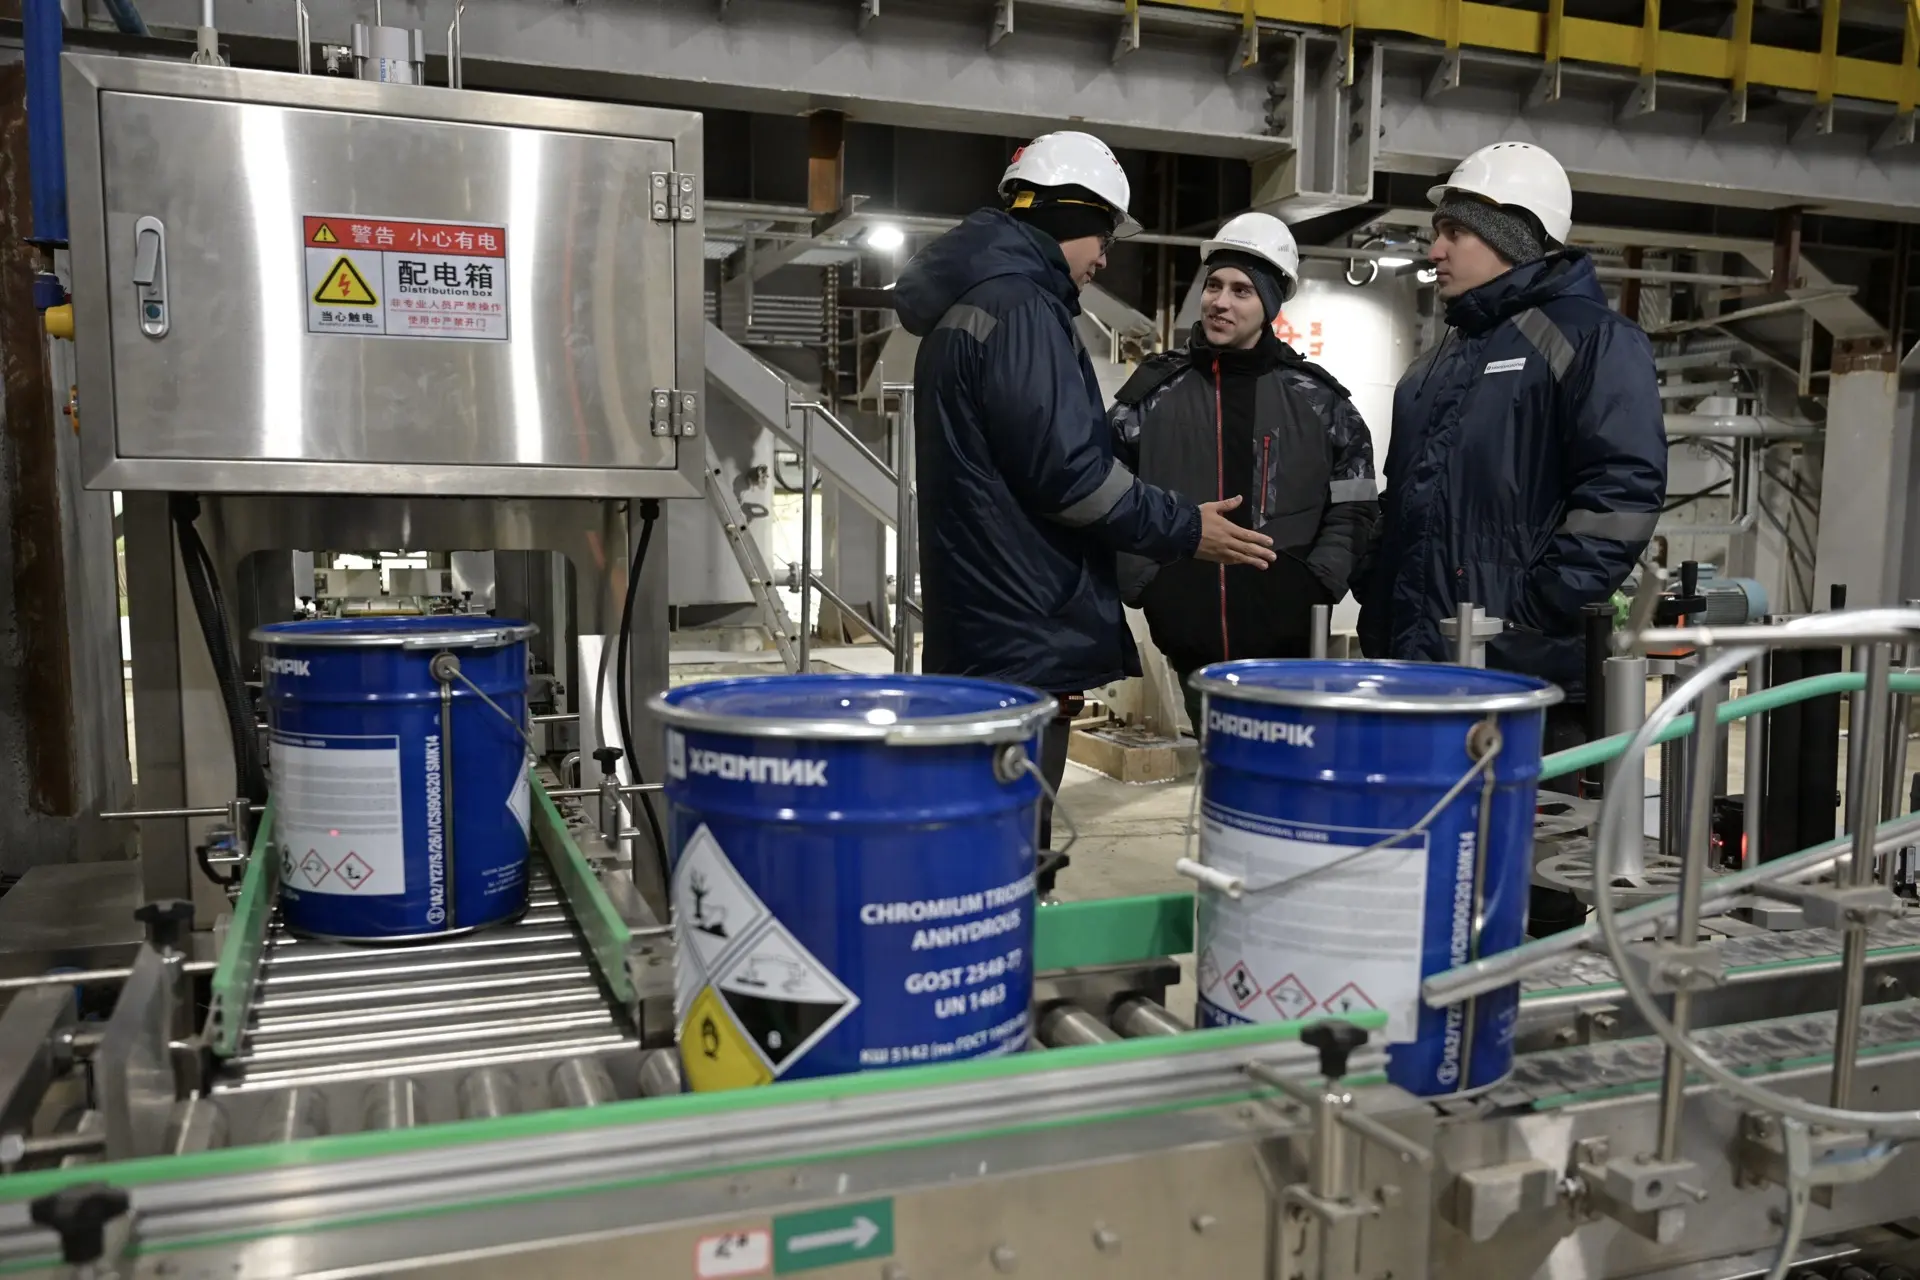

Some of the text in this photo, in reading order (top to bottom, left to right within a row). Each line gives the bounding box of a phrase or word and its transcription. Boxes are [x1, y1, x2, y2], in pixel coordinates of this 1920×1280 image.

[351, 224, 498, 251] 警告 小心有电
[398, 260, 494, 290] 配电箱
[399, 285, 493, 297] Distribution box
[321, 311, 375, 324] 当心触电
[390, 298, 502, 312] 非专业人员严禁操作
[425, 735, 441, 771] SMK14
[689, 747, 828, 787] ХРОМПИК
[860, 892, 985, 925] CHROMIUM
[904, 967, 964, 994] GOST
[935, 994, 966, 1019] UN
